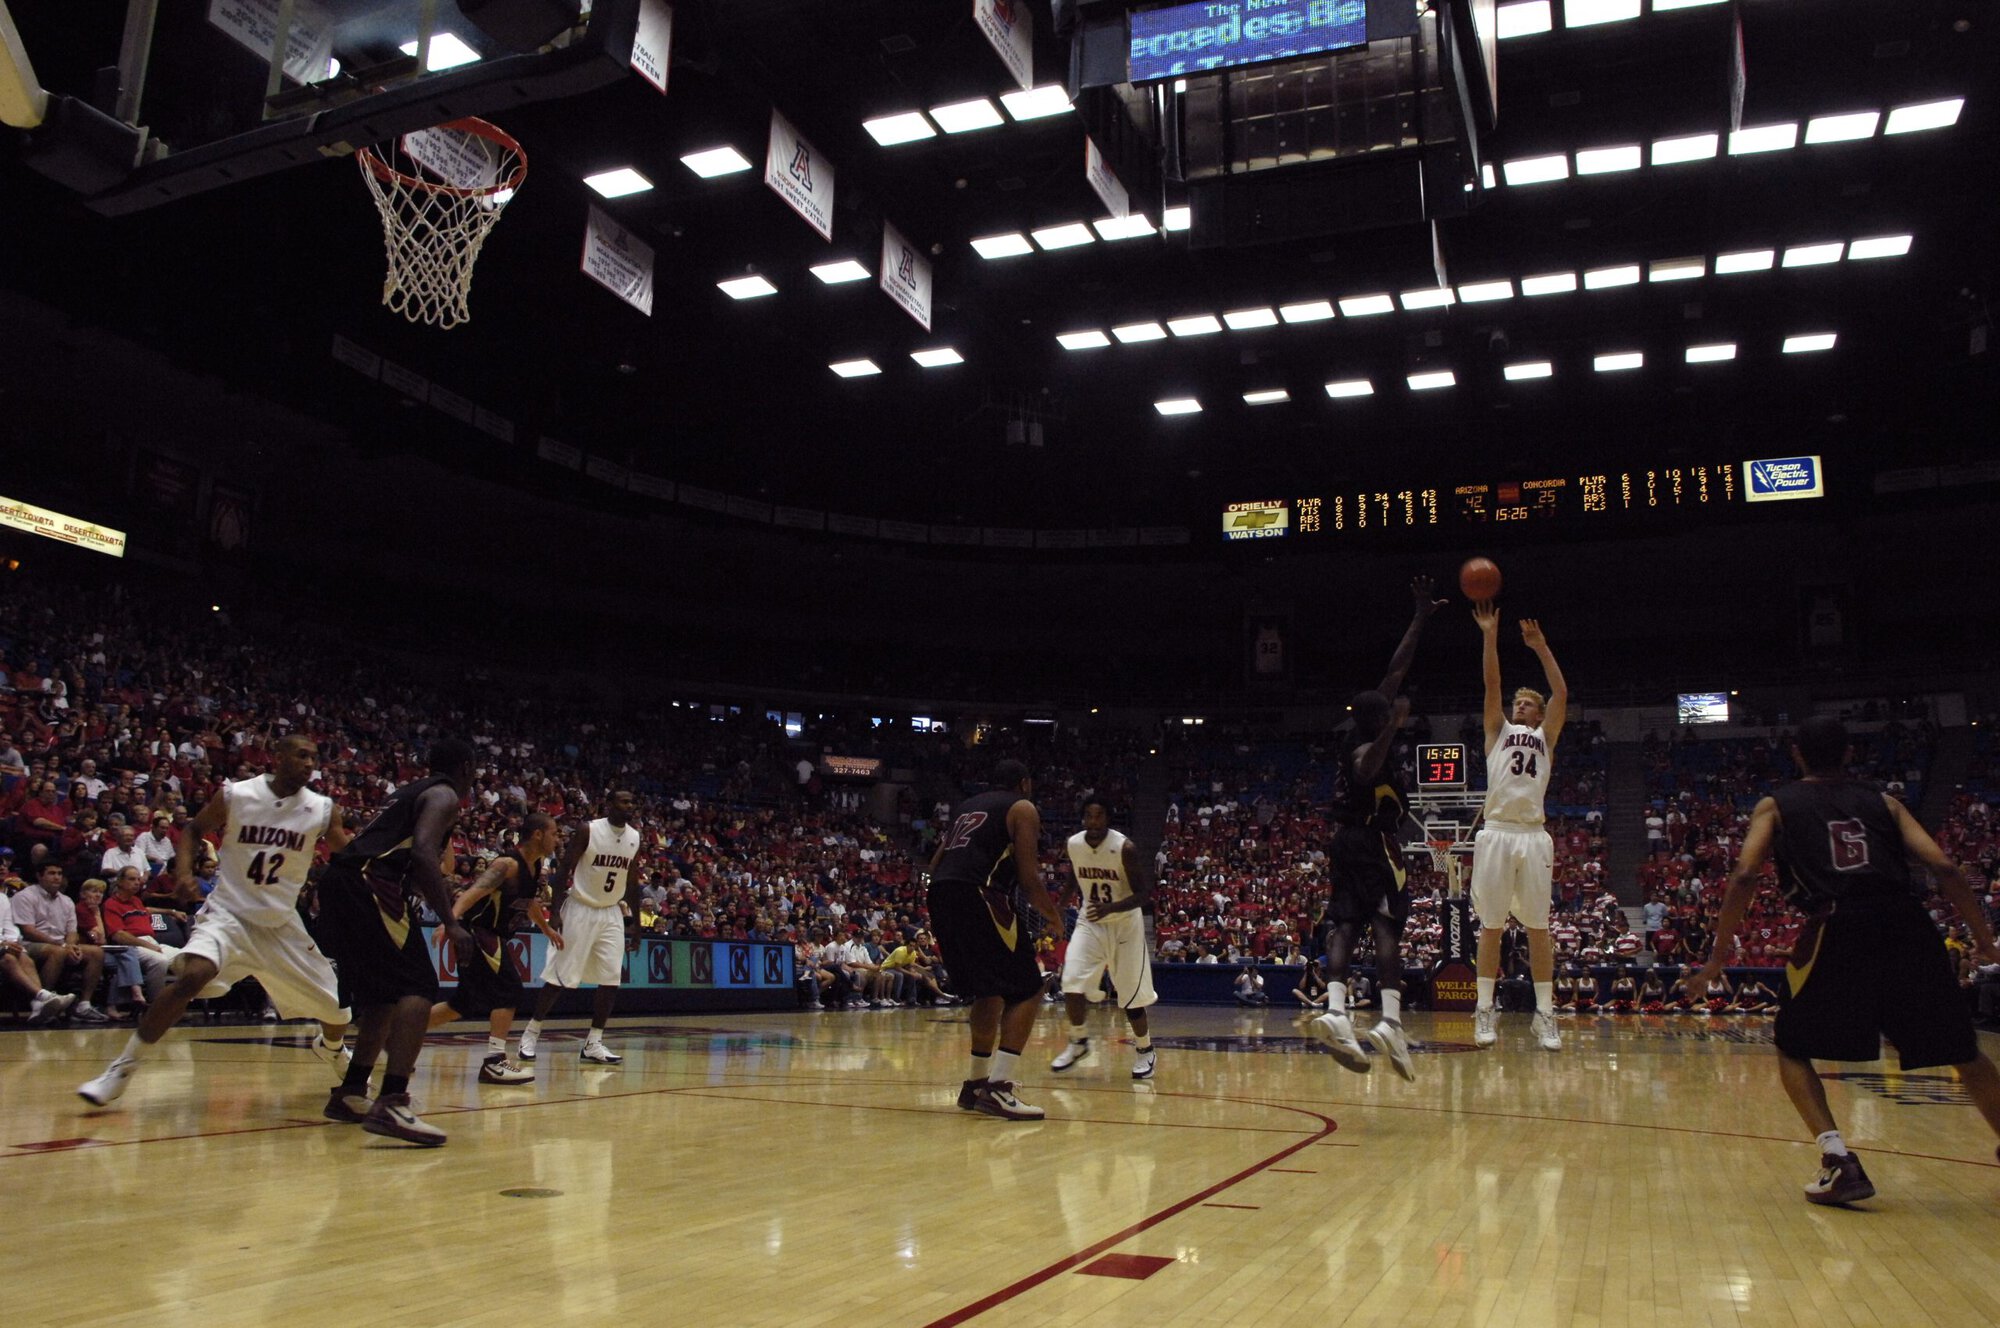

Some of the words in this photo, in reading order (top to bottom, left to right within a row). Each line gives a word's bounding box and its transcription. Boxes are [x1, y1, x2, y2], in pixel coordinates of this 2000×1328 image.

[1205, 4, 1240, 17] The
[634, 43, 655, 64] TBALL
[633, 51, 660, 80] IXTEEN
[786, 187, 804, 209] SWEET
[804, 207, 827, 231] SIXTEEN
[1579, 476, 1606, 485] PLYR
[1622, 473, 1629, 481] 6
[1647, 471, 1655, 479] 9
[1666, 469, 1680, 478] 10
[1692, 467, 1706, 476] 12
[1717, 465, 1732, 474] 15
[1766, 464, 1801, 472] Tucson
[1770, 470, 1808, 479] Electric
[1456, 485, 1488, 494] ARIZONA
[1523, 479, 1565, 489] CONCORDIA
[1585, 485, 1603, 493] PTS
[1622, 482, 1630, 490] 5
[1673, 478, 1681, 486] 7
[1699, 476, 1706, 484] 9
[1725, 474, 1732, 482] 4
[1775, 479, 1809, 487] Power
[1297, 498, 1321, 507] PLYR
[1336, 496, 1342, 504] 0
[1375, 493, 1389, 501] 34
[1398, 491, 1412, 499] 42
[1422, 490, 1436, 498] 43
[1539, 490, 1555, 502] 25
[1584, 493, 1606, 502] RBS
[1623, 491, 1630, 499] 2
[1674, 486, 1681, 495] 5
[1700, 485, 1707, 493] 4
[1725, 483, 1733, 491] 2
[1229, 501, 1282, 512] O'RIELLY
[1301, 507, 1318, 515] PTS
[1423, 499, 1436, 507] 12
[1466, 496, 1482, 507] 42
[1584, 502, 1606, 511] FLS
[1649, 498, 1656, 506] 0
[1700, 493, 1708, 502] 0
[24, 512, 54, 527] TOYOTA
[1300, 515, 1319, 524] RBS
[1406, 508, 1413, 516] 3
[1496, 507, 1528, 520] 15:26
[1300, 523, 1320, 532] FLS
[1359, 520, 1366, 528] 0
[64, 524, 93, 538] DESERT
[96, 532, 123, 546] TOYOTA
[1229, 529, 1283, 540] WATSON
[1427, 748, 1459, 759] 15:26
[1429, 762, 1455, 781] 33
[1511, 751, 1537, 778] 34
[238, 826, 305, 851] ARIZONA
[944, 811, 988, 850] 12
[1827, 817, 1870, 871] 6
[247, 851, 284, 885] 42
[592, 854, 631, 870] ARIZON
[1079, 867, 1119, 880] ARIZONA
[604, 871, 617, 893] 5
[1088, 882, 1112, 904] 43
[1450, 904, 1461, 958] ARIZONA
[1436, 981, 1477, 990] WELLS
[1438, 992, 1477, 1000] FARGO
